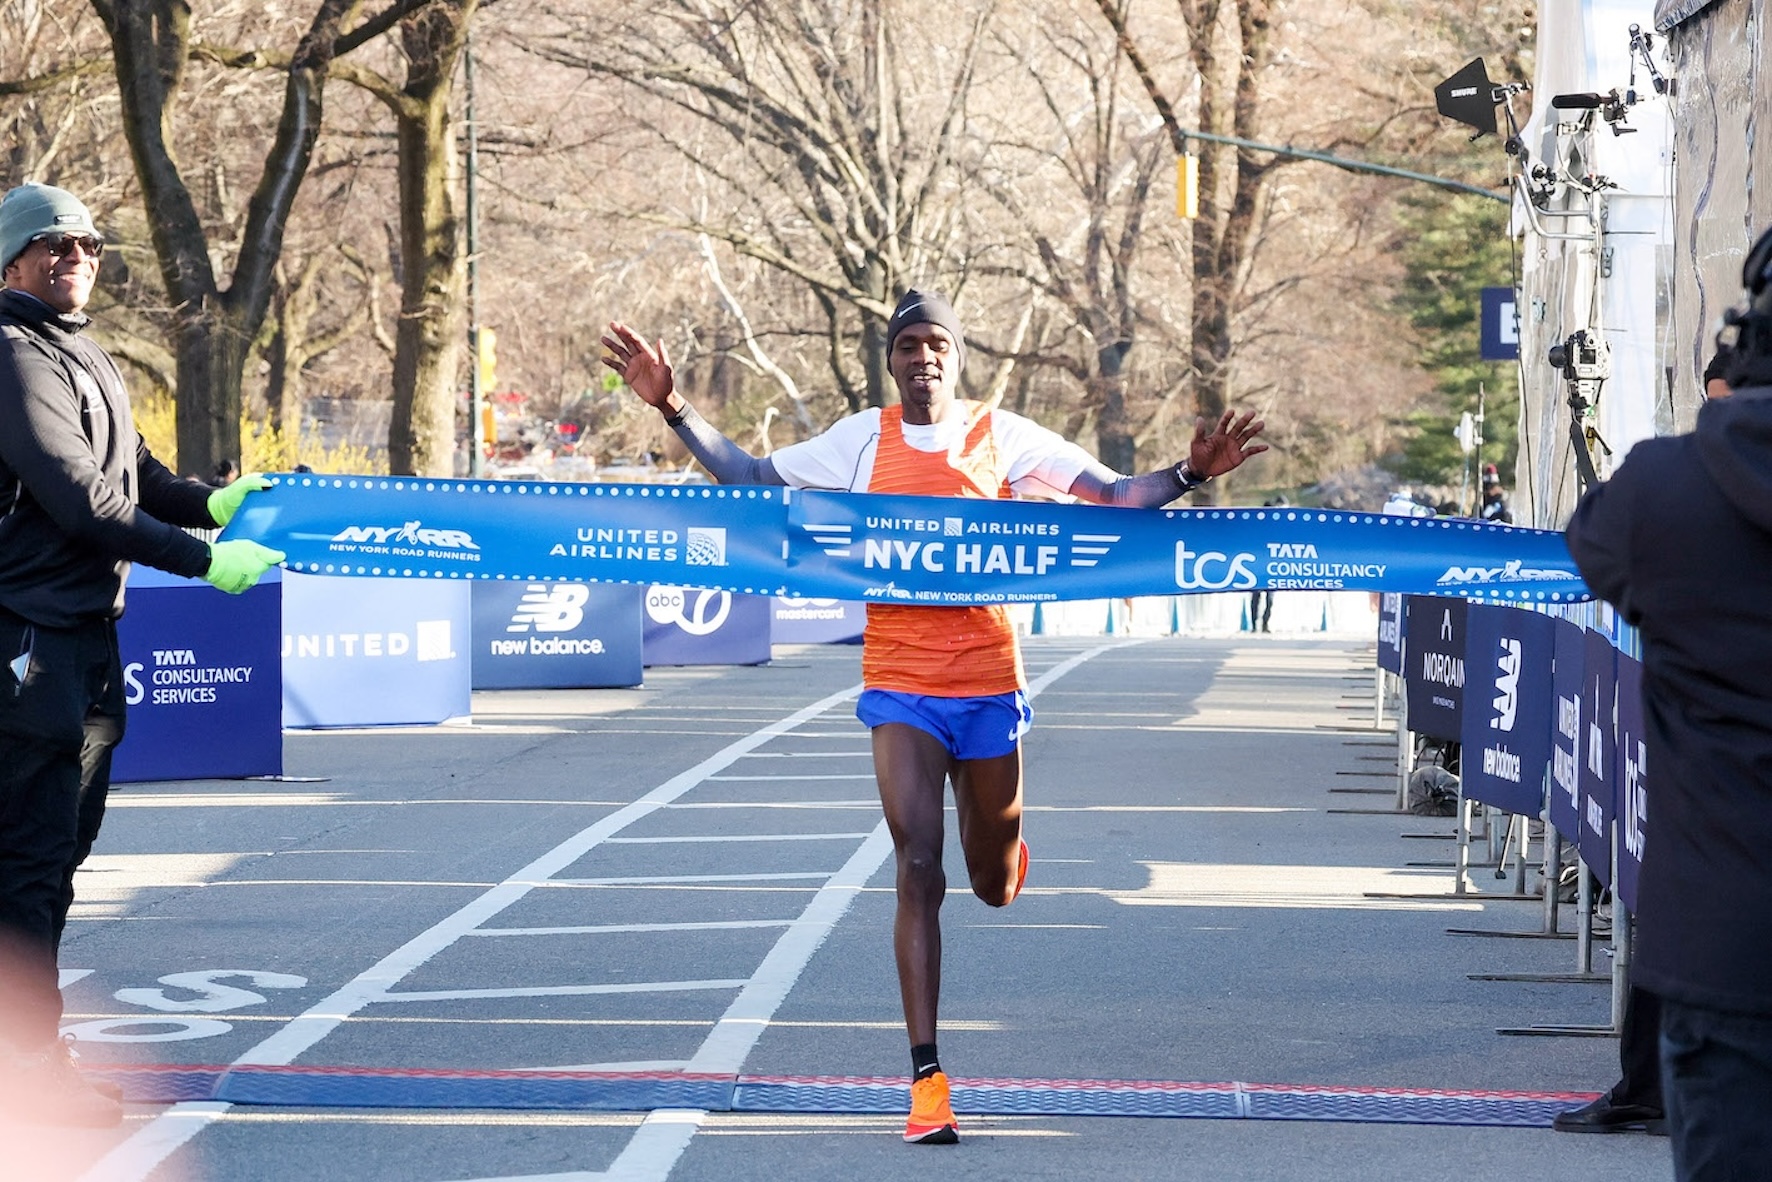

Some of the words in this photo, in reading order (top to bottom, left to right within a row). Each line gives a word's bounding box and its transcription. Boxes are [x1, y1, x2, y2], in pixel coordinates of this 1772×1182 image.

[331, 520, 481, 550] NYRR
[866, 517, 940, 532] UNITED
[967, 521, 1060, 536] AIRLINES
[577, 527, 679, 545] UNITED
[329, 543, 357, 552] NEW
[359, 545, 389, 555] YORK
[392, 547, 424, 557] ROAD
[427, 550, 481, 562] RUNNERS
[549, 543, 678, 561] AIRLINES
[864, 539, 945, 572] NYC
[956, 543, 1058, 575] HALF
[1267, 543, 1318, 559] TATA
[1175, 540, 1258, 590] tcs
[1267, 562, 1386, 578] CONSULTANCY
[1267, 578, 1344, 589] SERVICES
[649, 592, 681, 607] abc
[915, 590, 941, 600] NEW
[943, 592, 972, 602] YORK
[974, 593, 1005, 602] ROAD
[1007, 593, 1058, 601] RUNNERS
[776, 606, 844, 619] mastercard
[491, 639, 527, 656] new
[530, 636, 602, 655] balance
[152, 650, 196, 666] TATA
[152, 667, 252, 685] CONSULTANCY
[152, 687, 216, 704] SERVICES
